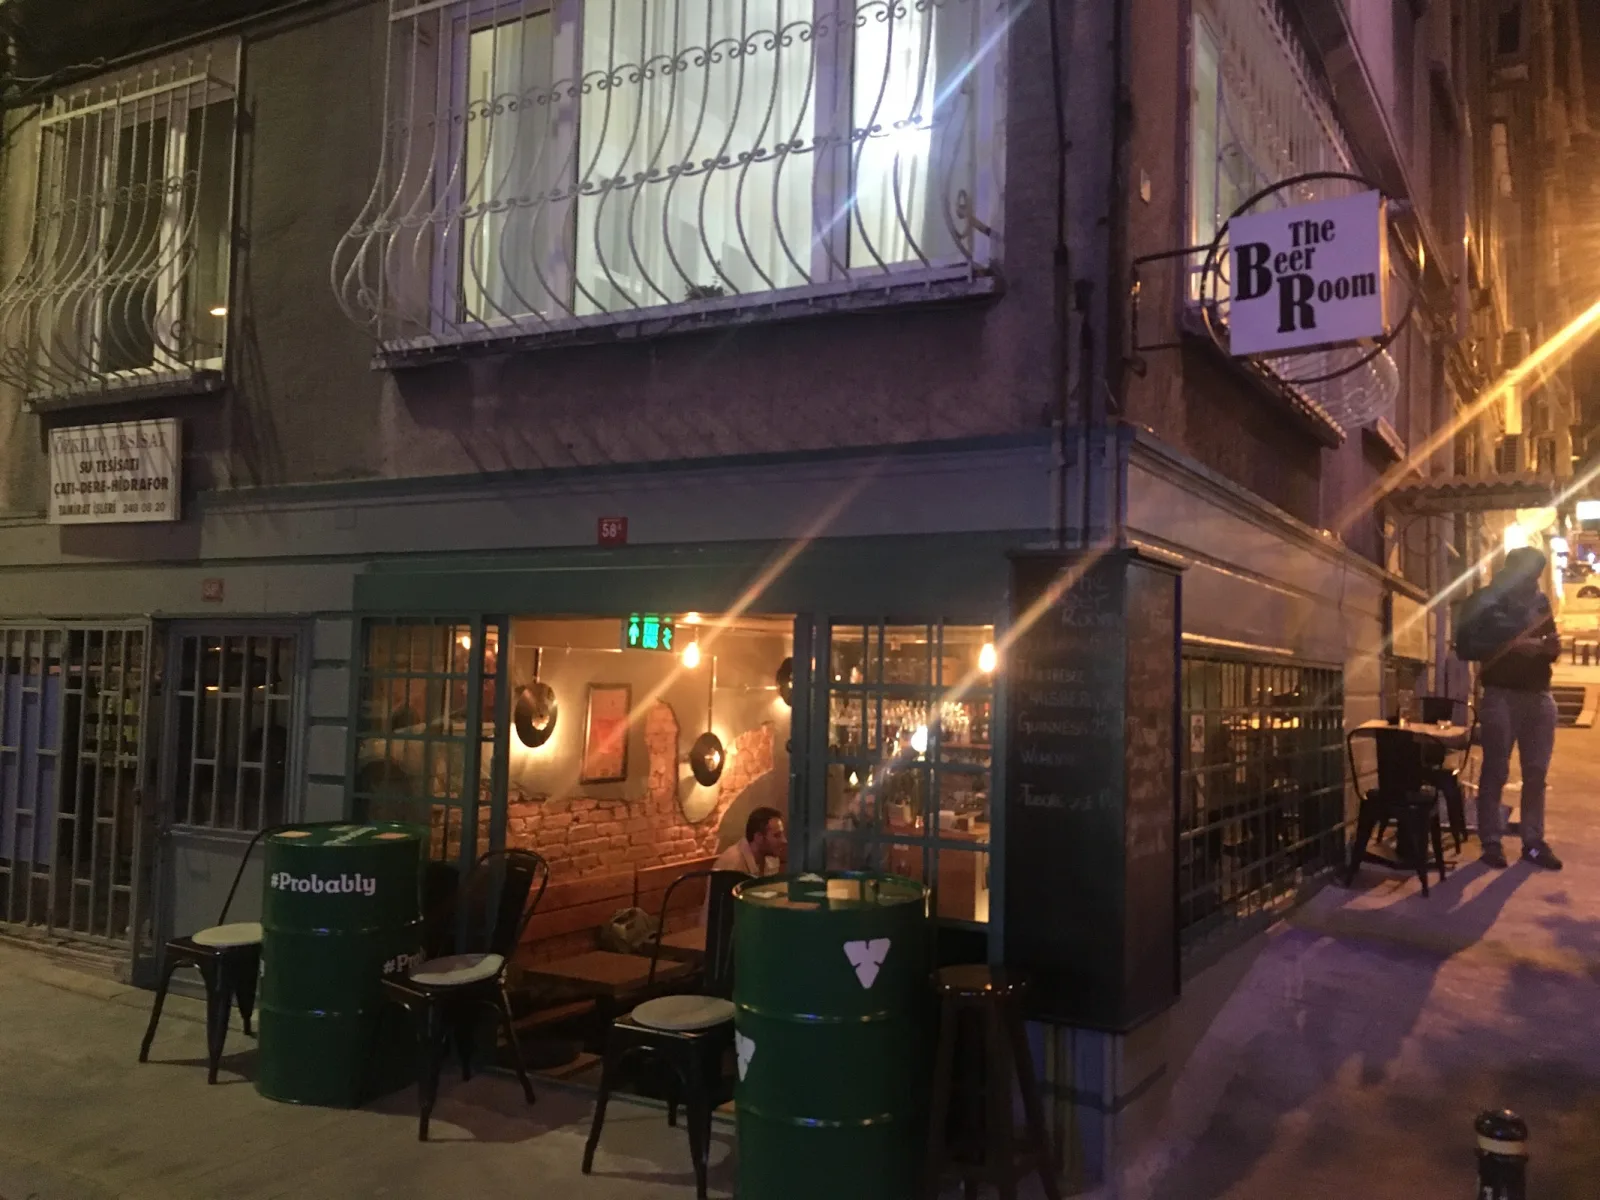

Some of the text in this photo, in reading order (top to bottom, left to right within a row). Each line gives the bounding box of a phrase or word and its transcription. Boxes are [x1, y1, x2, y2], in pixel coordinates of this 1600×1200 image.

[1288, 218, 1336, 247] The
[1234, 241, 1316, 302] Beer
[1276, 272, 1376, 334] Room
[79, 461, 93, 474] SU
[270, 871, 377, 896] #Probably
